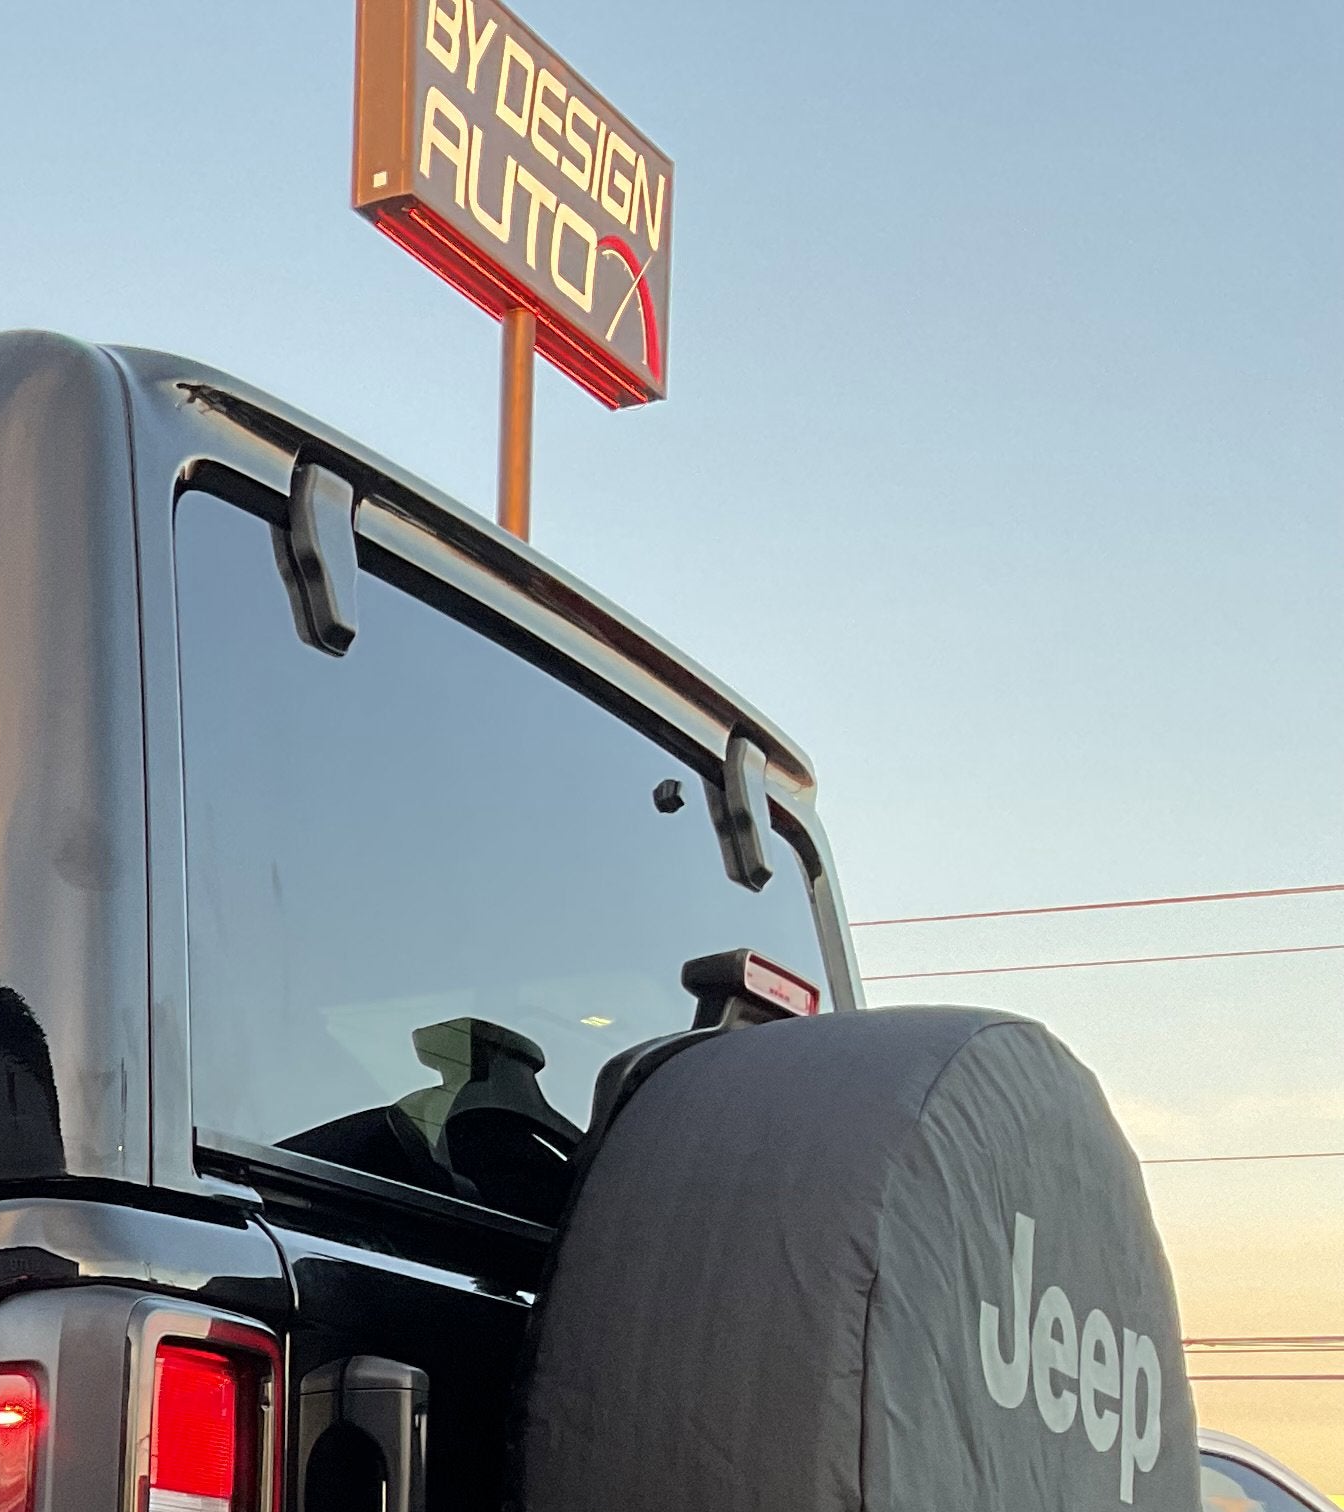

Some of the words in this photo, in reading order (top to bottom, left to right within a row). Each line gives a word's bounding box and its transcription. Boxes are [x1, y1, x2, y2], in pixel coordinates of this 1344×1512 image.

[419, 86, 598, 313] AUTO
[425, 0, 498, 94] BY
[495, 34, 666, 251] DESIGN
[979, 1211, 1162, 1505] Jeep
